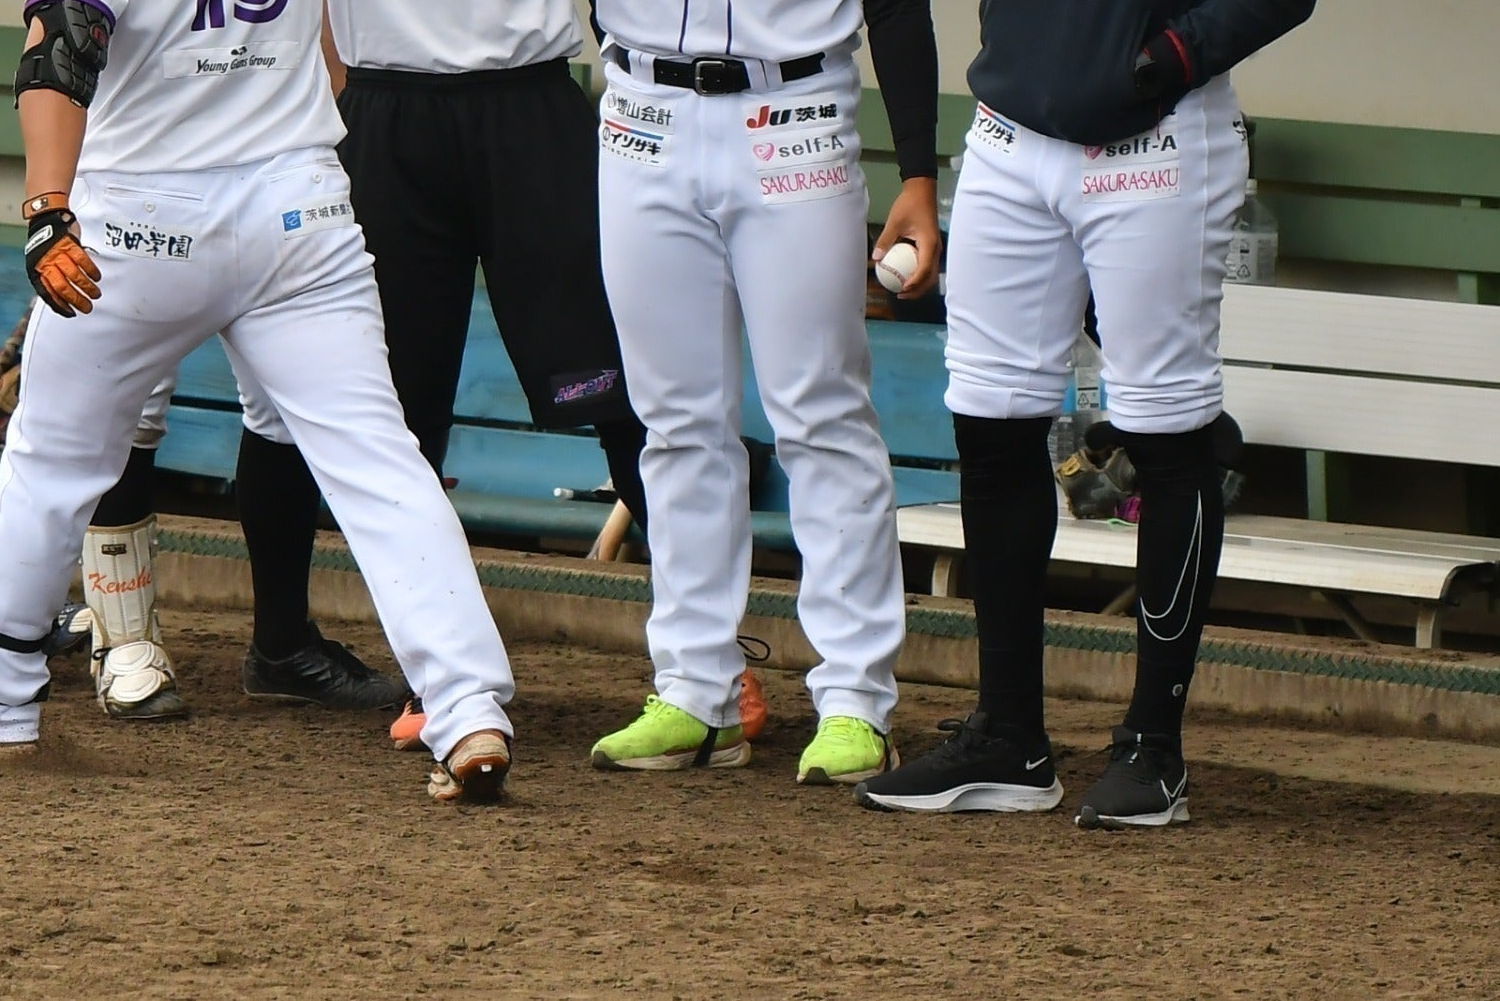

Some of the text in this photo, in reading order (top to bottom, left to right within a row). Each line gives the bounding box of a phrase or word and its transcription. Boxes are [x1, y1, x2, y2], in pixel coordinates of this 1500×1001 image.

[196, 58, 230, 74] Young
[249, 54, 277, 69] Group
[617, 96, 673, 127] 増山会計
[977, 117, 1016, 145] イソザキ
[609, 131, 662, 156] イソザキ
[778, 134, 845, 158] self-A
[1105, 134, 1178, 158] self-A
